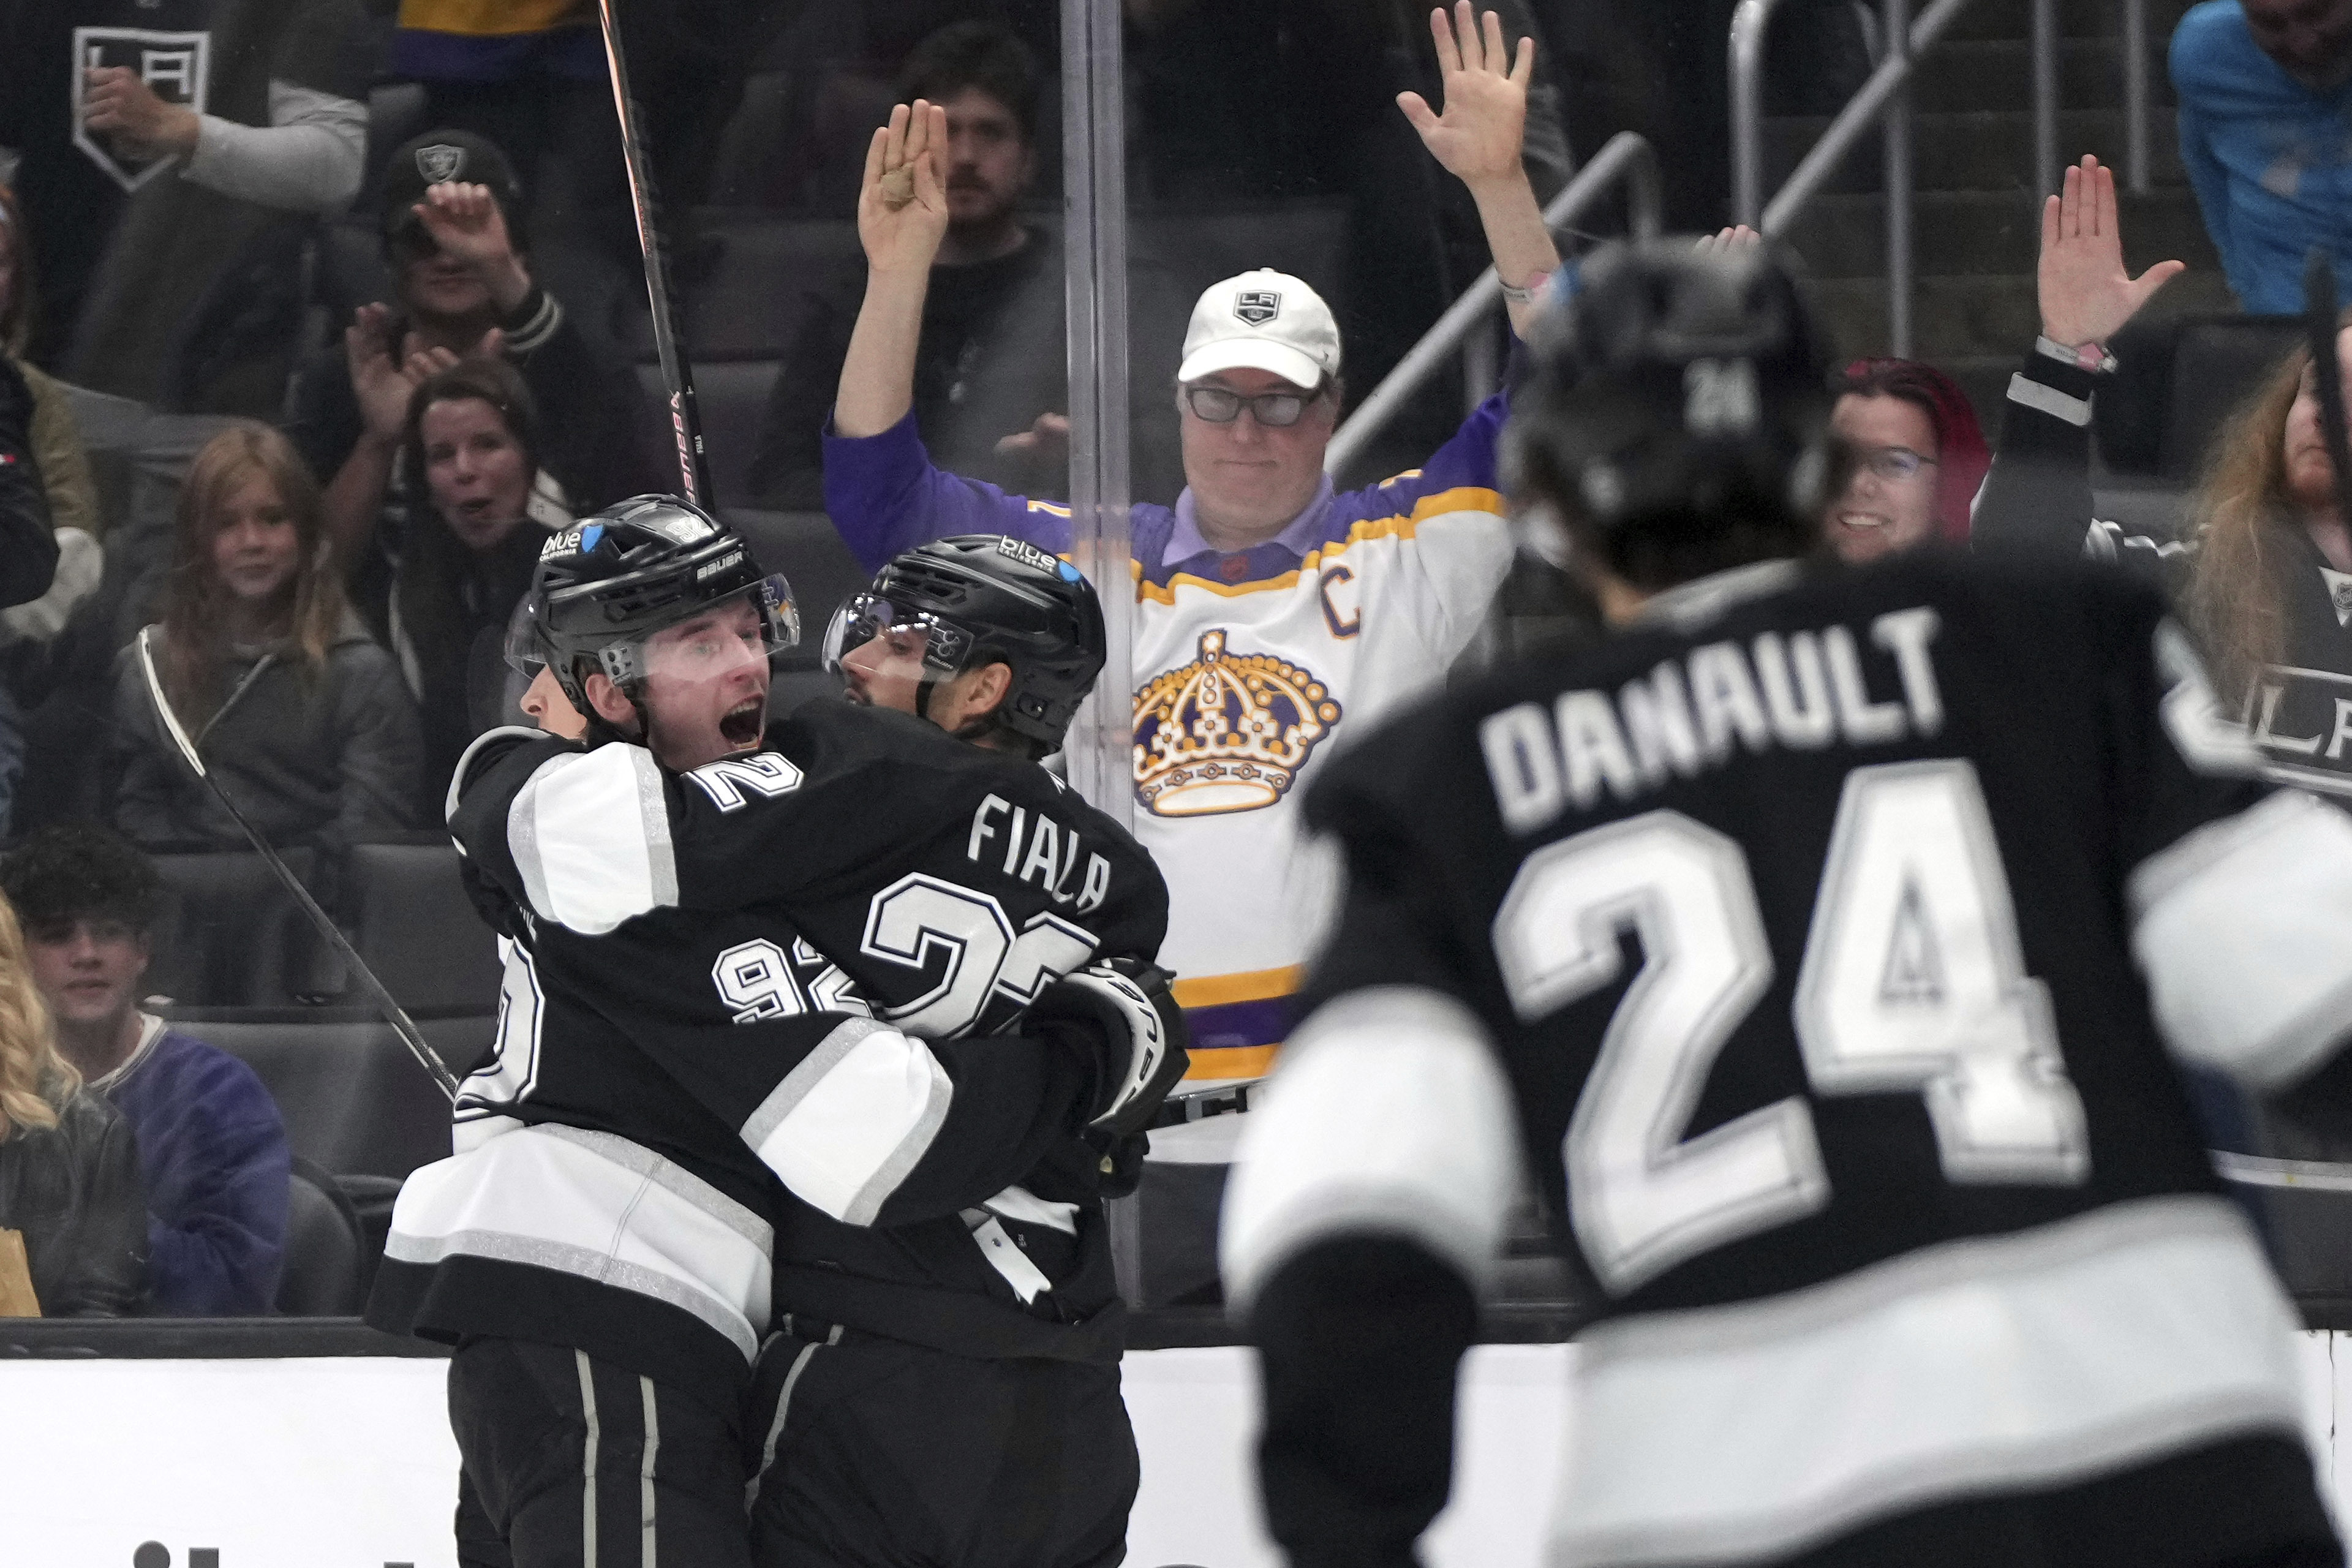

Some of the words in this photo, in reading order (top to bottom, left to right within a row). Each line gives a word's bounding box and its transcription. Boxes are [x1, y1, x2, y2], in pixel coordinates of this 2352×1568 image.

[89, 47, 190, 94] A
[541, 531, 581, 554] blue
[665, 517, 714, 543] 92
[1000, 535, 1057, 567] blue
[696, 551, 742, 580] BAUER
[1321, 565, 1360, 640] C
[1480, 606, 1942, 835] DANAULT
[967, 793, 1110, 915] FIALA
[1490, 756, 2092, 1298] 24
